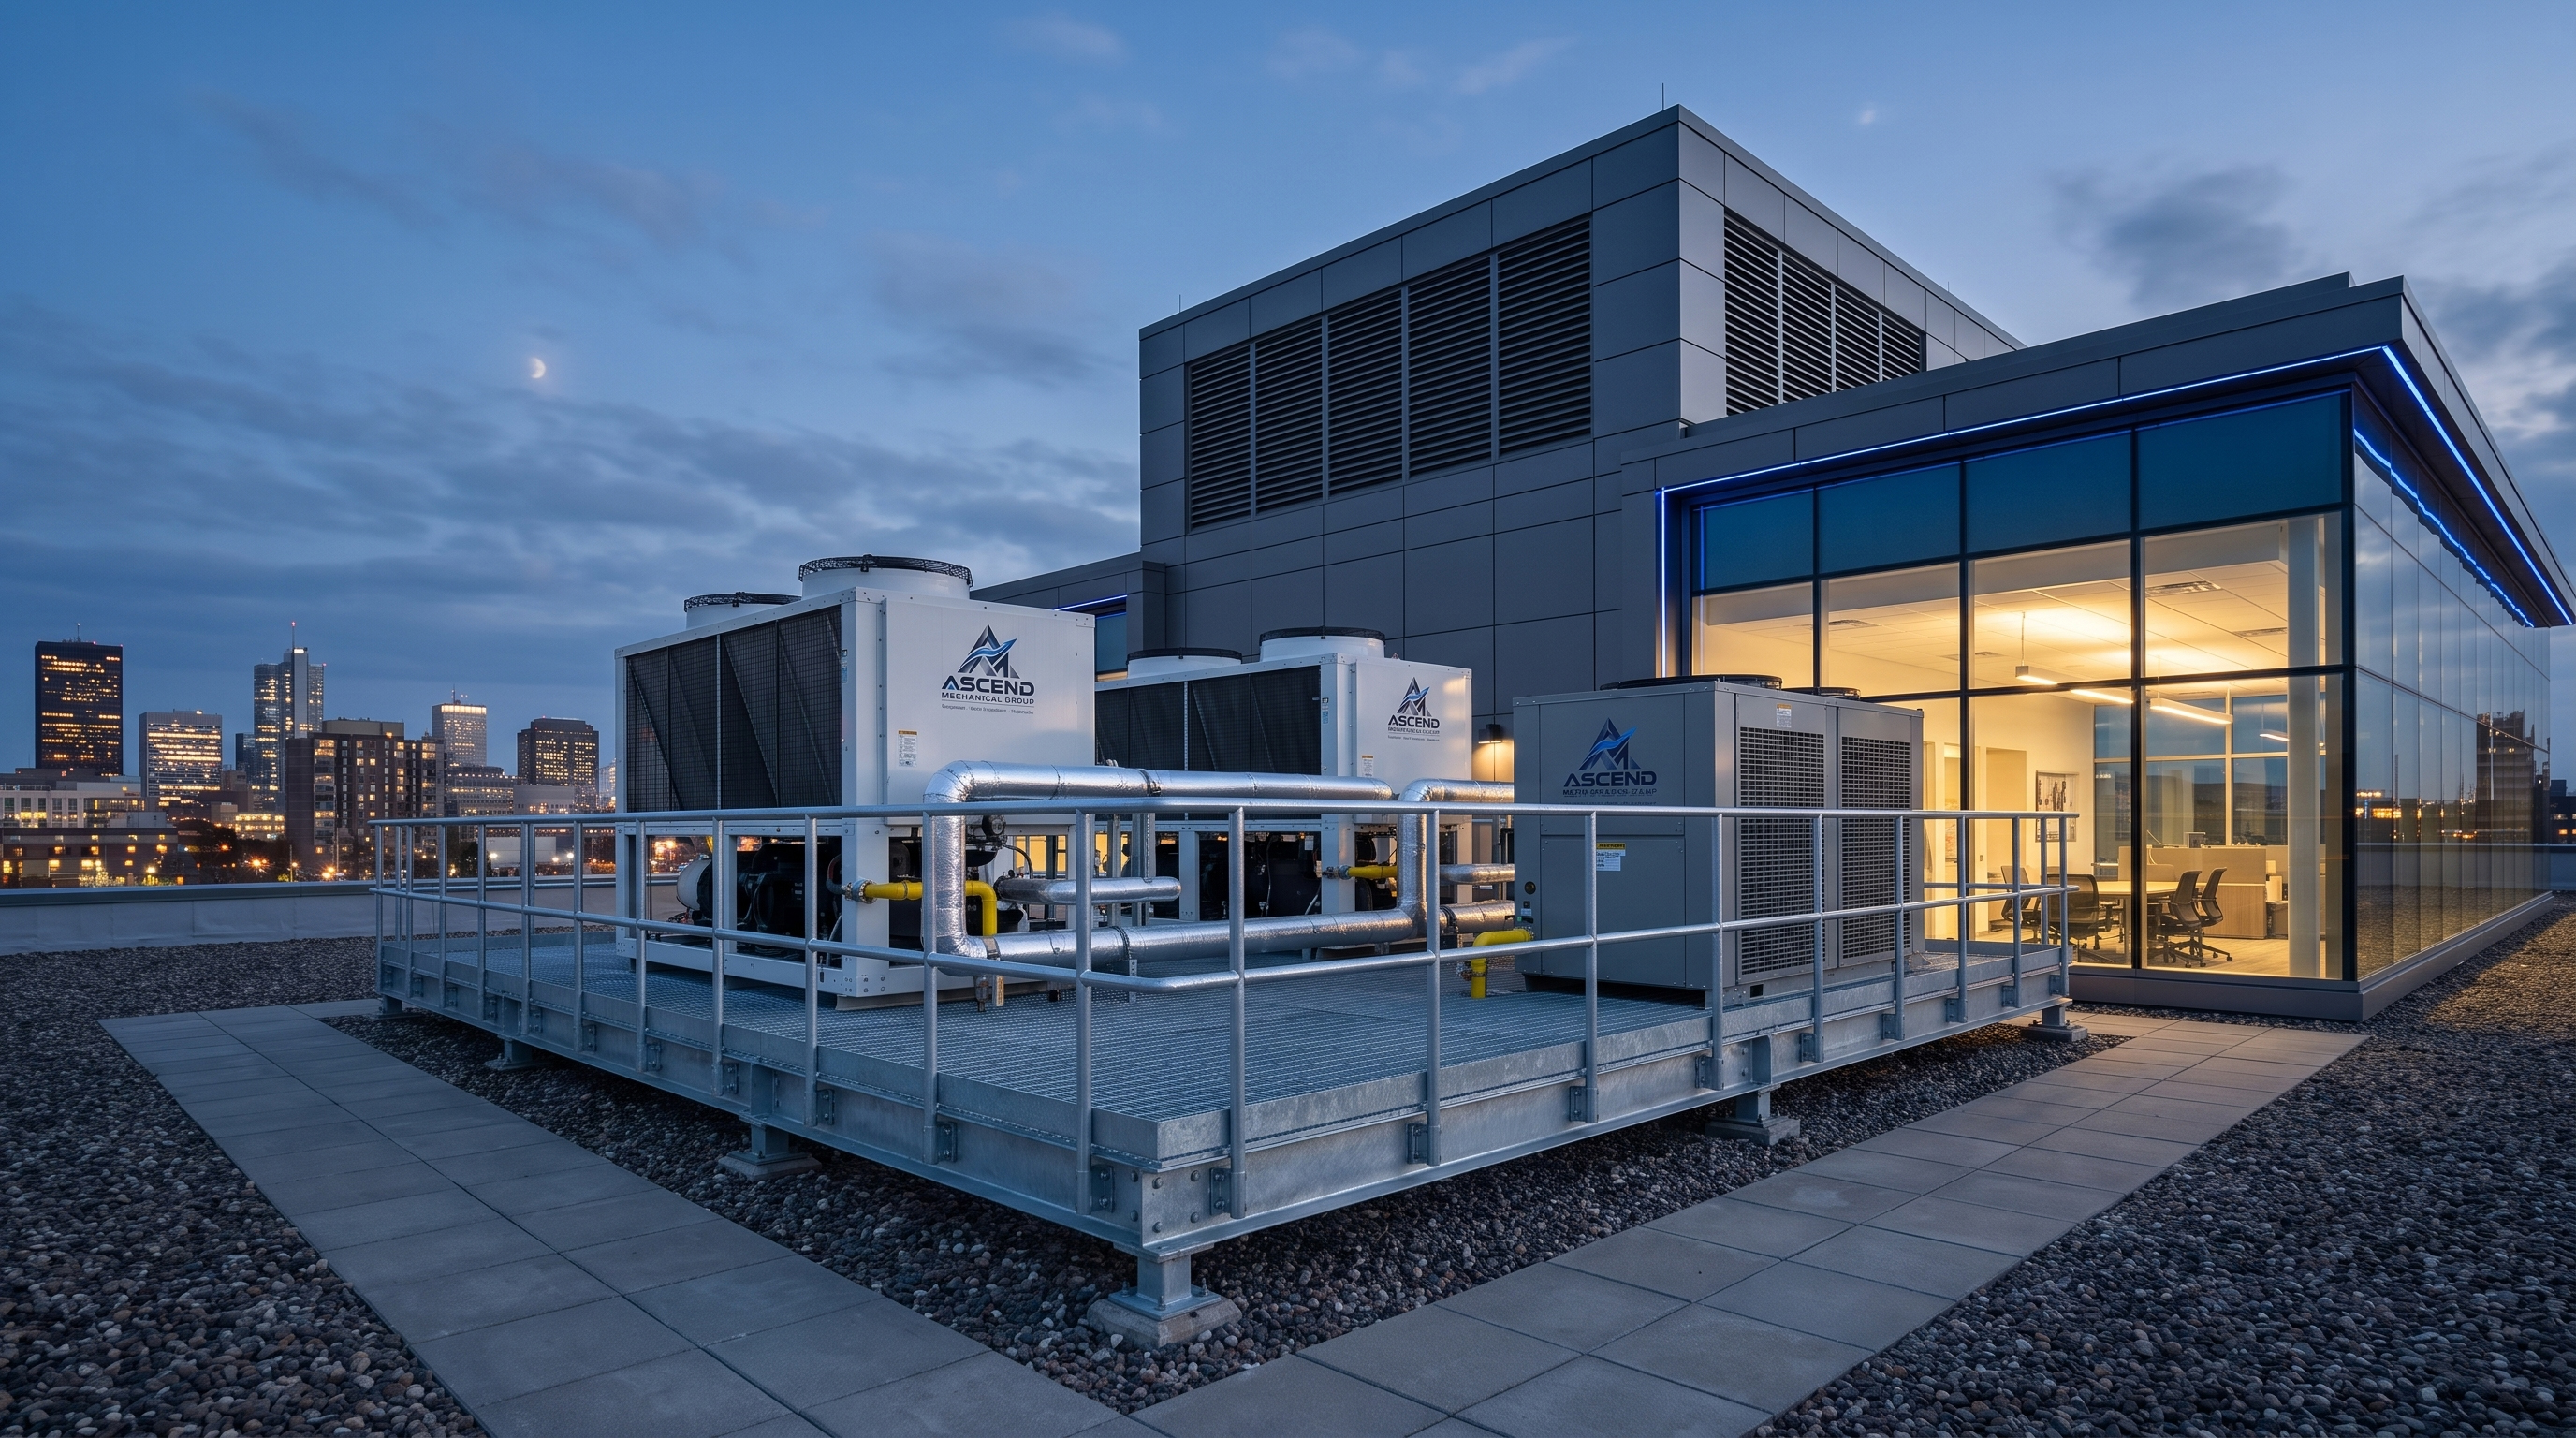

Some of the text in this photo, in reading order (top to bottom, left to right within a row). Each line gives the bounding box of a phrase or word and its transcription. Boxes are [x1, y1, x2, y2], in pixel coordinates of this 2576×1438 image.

[942, 675, 1035, 697] ASCEND
[1388, 714, 1440, 729] ASCEND
[1563, 770, 1657, 787] ASCEND
